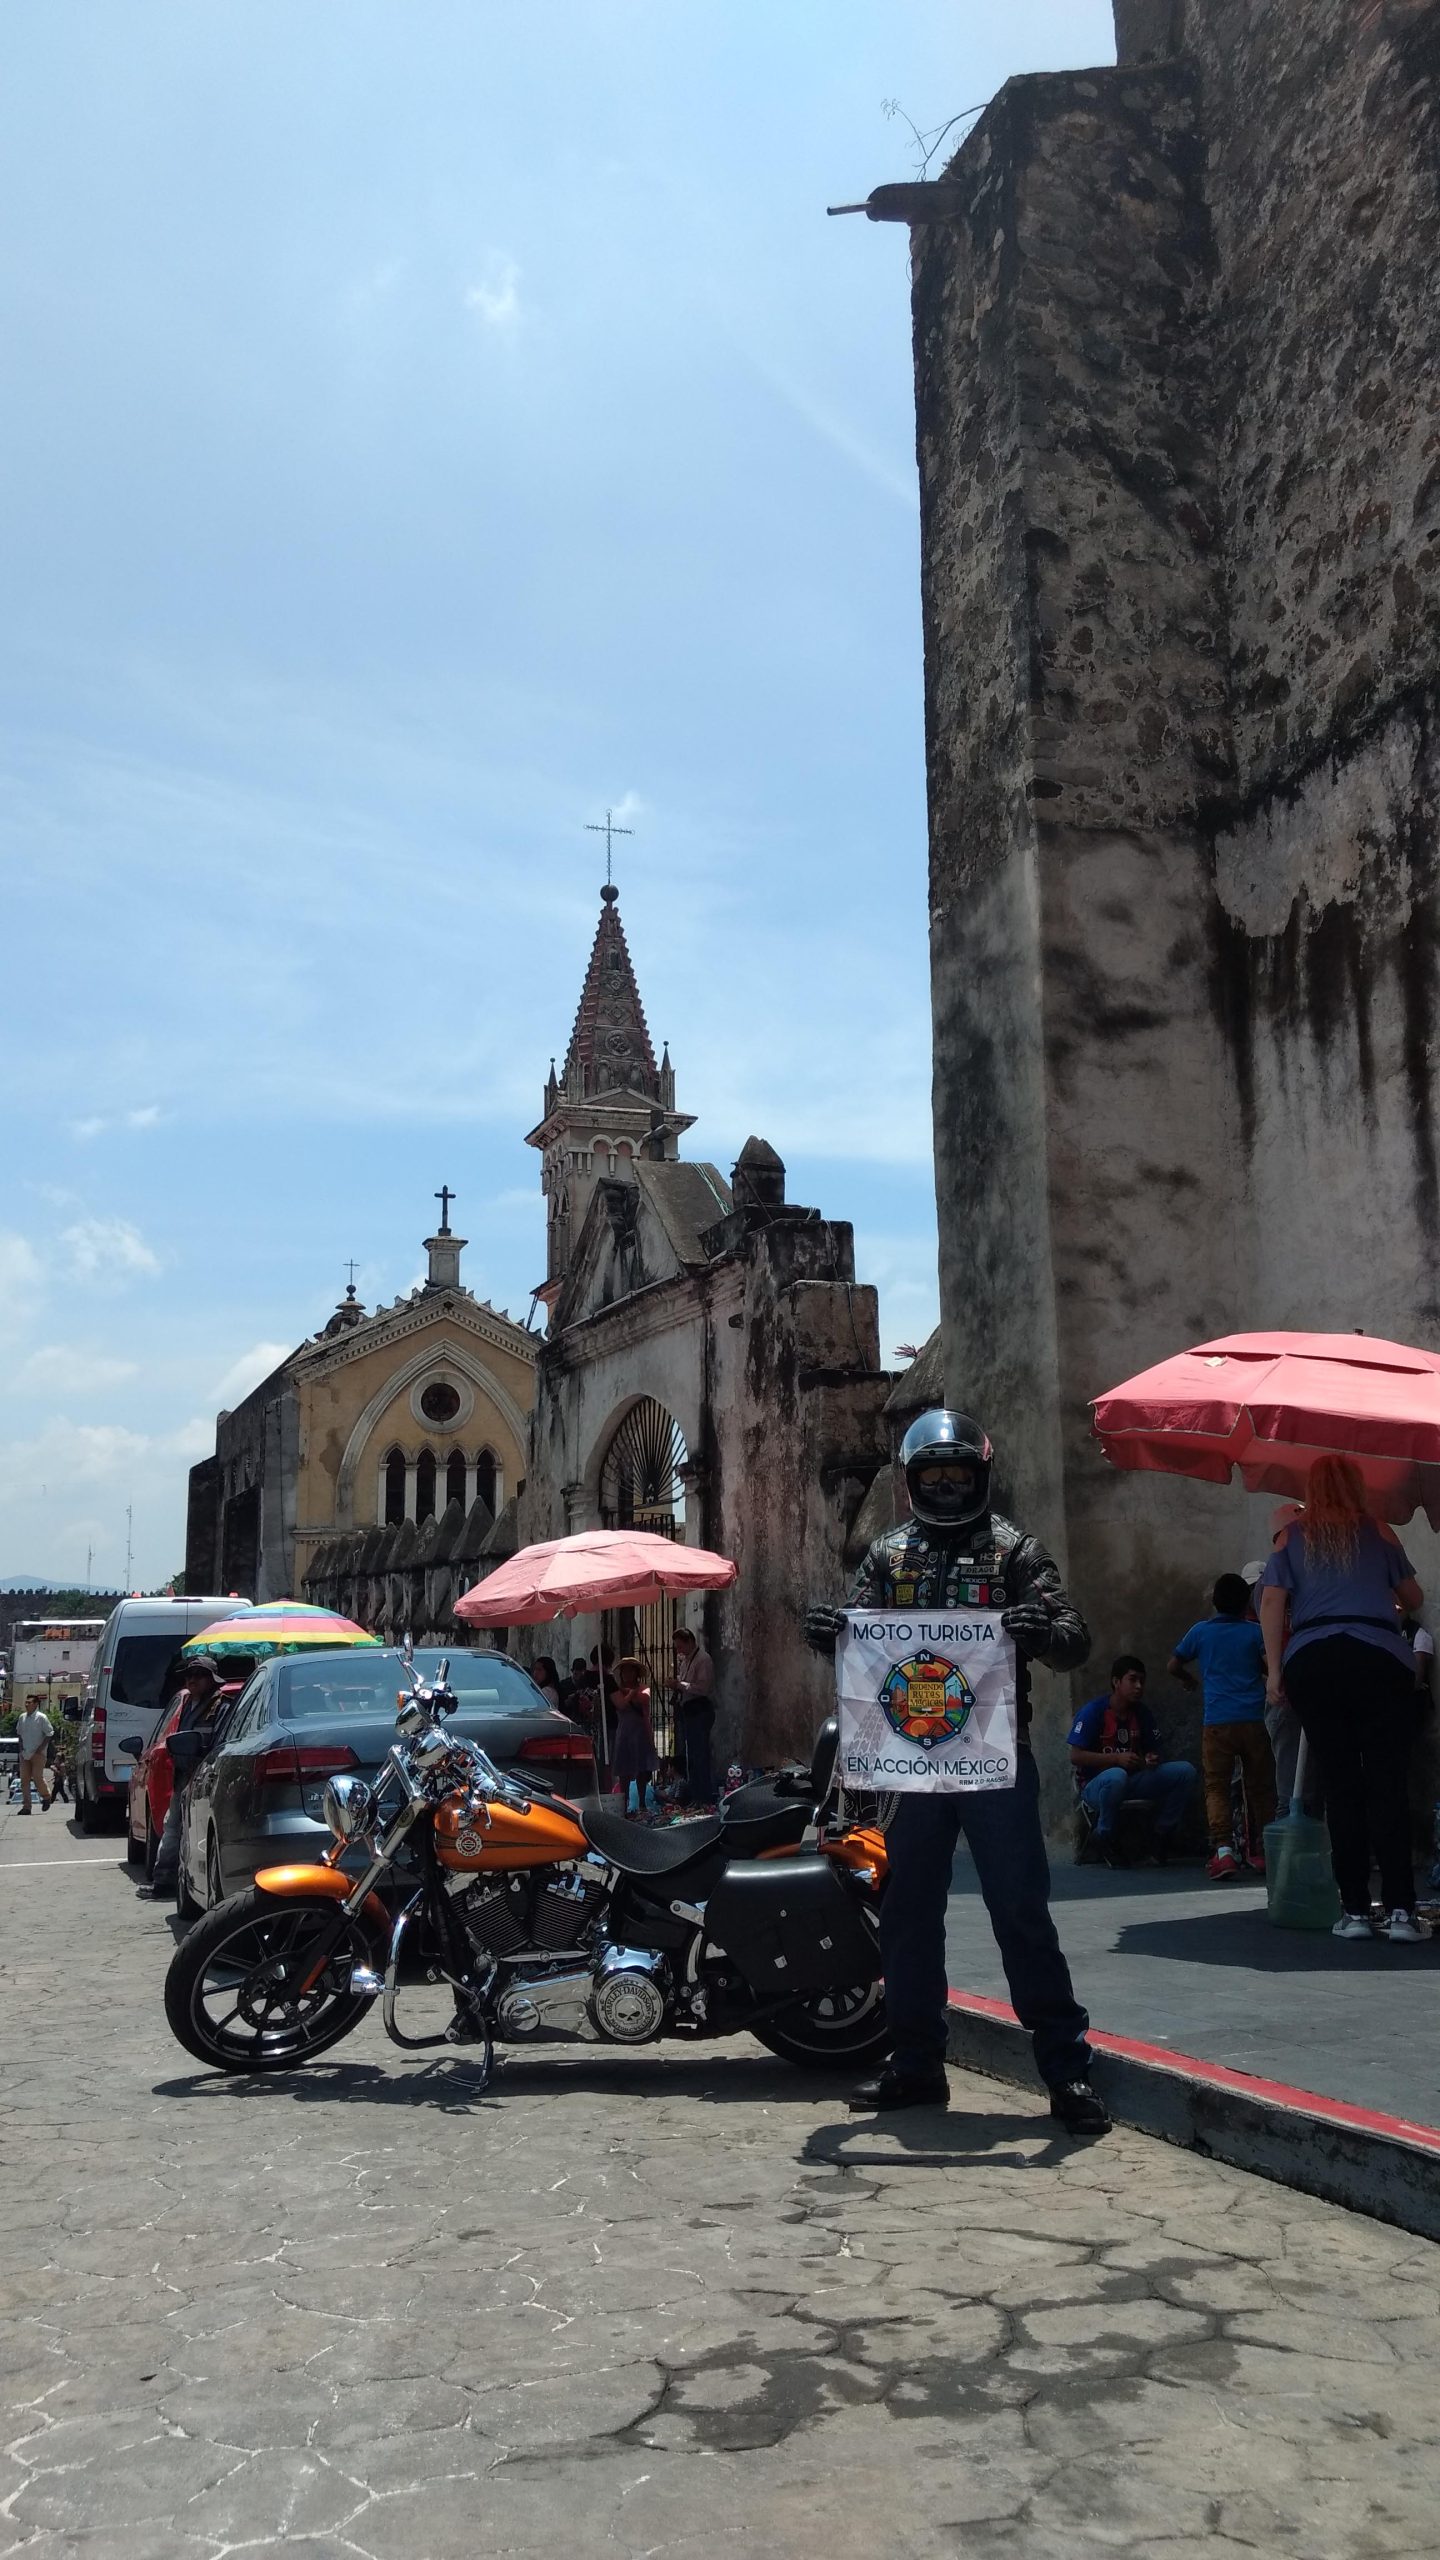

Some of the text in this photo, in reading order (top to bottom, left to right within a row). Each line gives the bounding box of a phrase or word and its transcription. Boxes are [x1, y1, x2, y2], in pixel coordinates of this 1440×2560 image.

[980, 1552, 1001, 1561] HOG
[853, 1623, 996, 1642] MOTO TURISTA
[920, 1653, 930, 1661] N
[963, 1695, 973, 1704] E
[923, 1738, 932, 1746] S
[847, 1755, 1009, 1776] EN ACCIÓN MÉXICO
